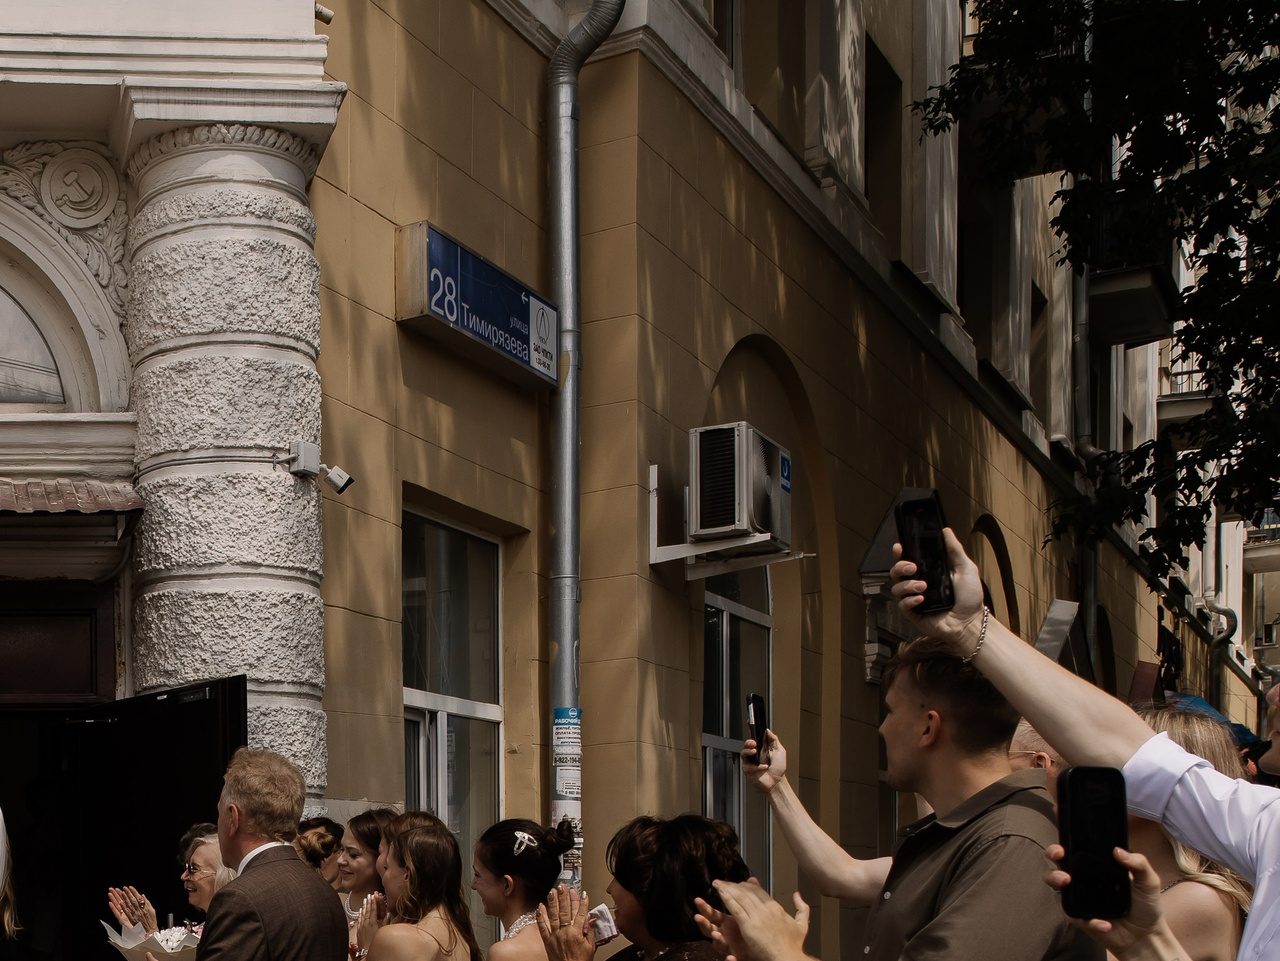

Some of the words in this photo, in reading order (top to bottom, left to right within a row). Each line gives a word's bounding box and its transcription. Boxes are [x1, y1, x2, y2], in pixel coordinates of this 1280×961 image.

[430, 267, 457, 322] 28
[461, 302, 529, 361] Тимирязева
[509, 315, 529, 335] улица
